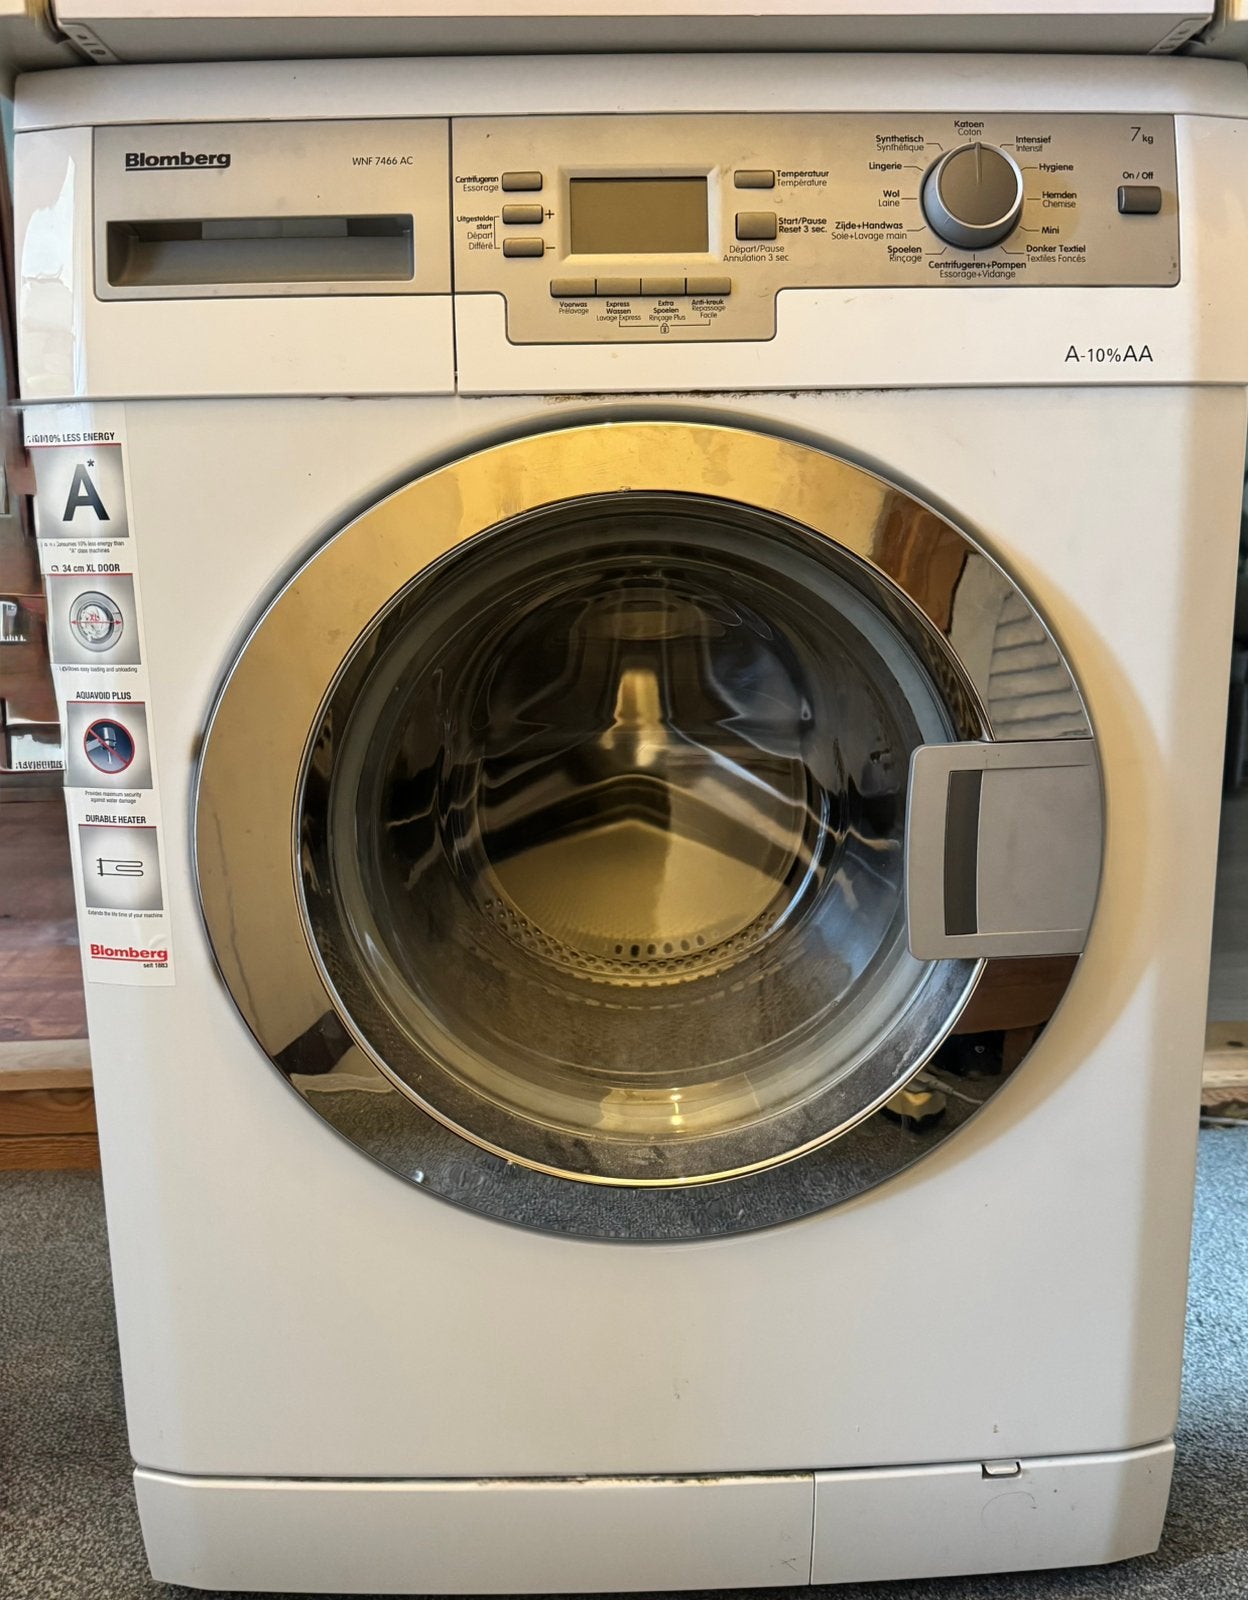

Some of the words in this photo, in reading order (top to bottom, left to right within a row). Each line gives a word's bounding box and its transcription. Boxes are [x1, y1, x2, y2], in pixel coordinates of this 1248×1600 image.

[954, 120, 985, 128] Katoen
[957, 128, 982, 136] Coton
[1130, 126, 1141, 142] 7
[1142, 134, 1154, 144] kg
[876, 134, 924, 144] Synthetisch
[1015, 135, 1051, 144] Intensief
[876, 143, 925, 152] Synthétique
[1016, 144, 1043, 152] Intensif
[125, 152, 231, 171] Blomberg
[352, 156, 373, 166] WNF
[374, 156, 398, 166] 7466
[399, 155, 413, 165] AC
[869, 162, 903, 171] Lingerie
[1039, 163, 1074, 172] Hygiene
[776, 170, 830, 179] Temperatuur
[1122, 171, 1135, 179] On
[1141, 171, 1154, 179] Off
[455, 176, 499, 184] Centrifugeren
[776, 179, 828, 188] Température
[463, 184, 499, 193] Essorage
[883, 190, 900, 198] Wol
[1042, 191, 1077, 199] Hemden
[878, 199, 900, 207] Laine
[1043, 200, 1077, 208] Chemise
[456, 215, 494, 223] Uitgestelde
[778, 217, 828, 225] Start/Pause
[778, 225, 801, 233] Reset
[835, 221, 904, 231] Zijde+Handwas
[1041, 225, 1060, 234] Mini
[467, 231, 493, 241] Départ
[831, 232, 884, 241] Soie+Lavage
[468, 242, 494, 250] Différé
[729, 244, 785, 254] Départ/Pause
[887, 245, 922, 255] Spoelen
[1026, 245, 1056, 253] Donker
[1058, 244, 1086, 253] Textiel
[723, 254, 766, 263] Annulation
[768, 254, 774, 262] 3
[889, 254, 922, 264] Rinçage
[1027, 254, 1056, 262] Textiles
[1058, 253, 1086, 263] Foncés
[928, 260, 1027, 271] Centrifugeren+Pompen
[939, 270, 1016, 280] Essorage+Vidange
[558, 307, 589, 315] Prélavage
[653, 306, 679, 314] Spoelen
[1064, 345, 1154, 362] A-10%AA
[62, 433, 81, 442] LESS
[83, 432, 115, 441] ENERGY
[62, 564, 72, 572] 34
[86, 564, 96, 572] XL
[98, 563, 120, 572] DOOR
[76, 691, 110, 700] AQUAVOID
[112, 691, 132, 700] PLUS
[86, 814, 117, 823] DURABLE
[118, 815, 147, 824] HEATER
[90, 944, 168, 962] Blomberg
